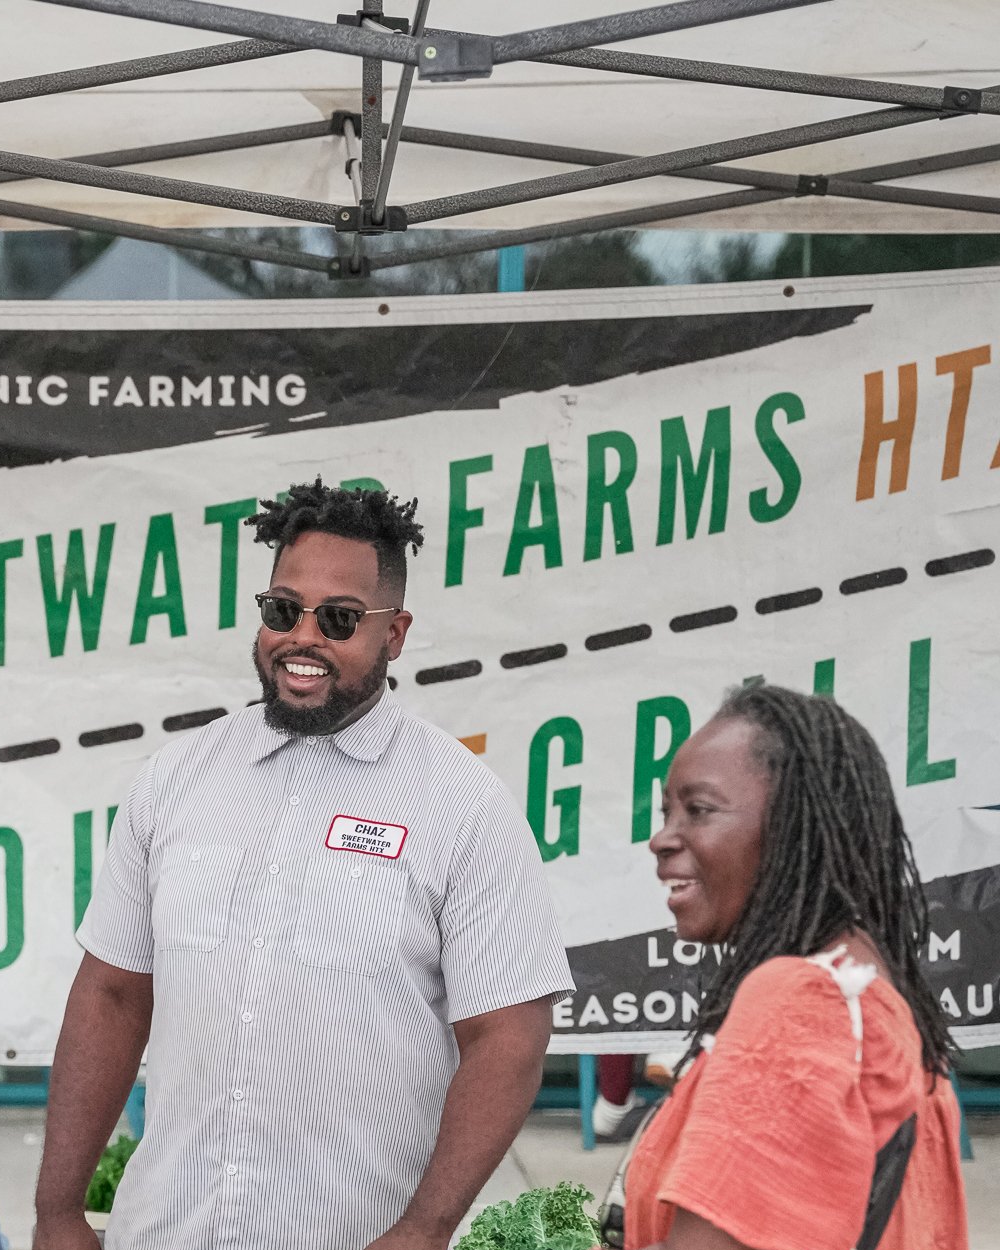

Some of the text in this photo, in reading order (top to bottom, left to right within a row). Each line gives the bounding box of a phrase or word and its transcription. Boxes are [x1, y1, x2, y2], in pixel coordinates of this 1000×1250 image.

[89, 374, 307, 408] FARMING
[444, 392, 806, 589] FARMS
[855, 344, 1000, 502] HT
[527, 637, 957, 863] GRL
[341, 833, 391, 848] SWEETWATER
[354, 823, 387, 838] CHAZ
[341, 840, 385, 854] FARMS HTX
